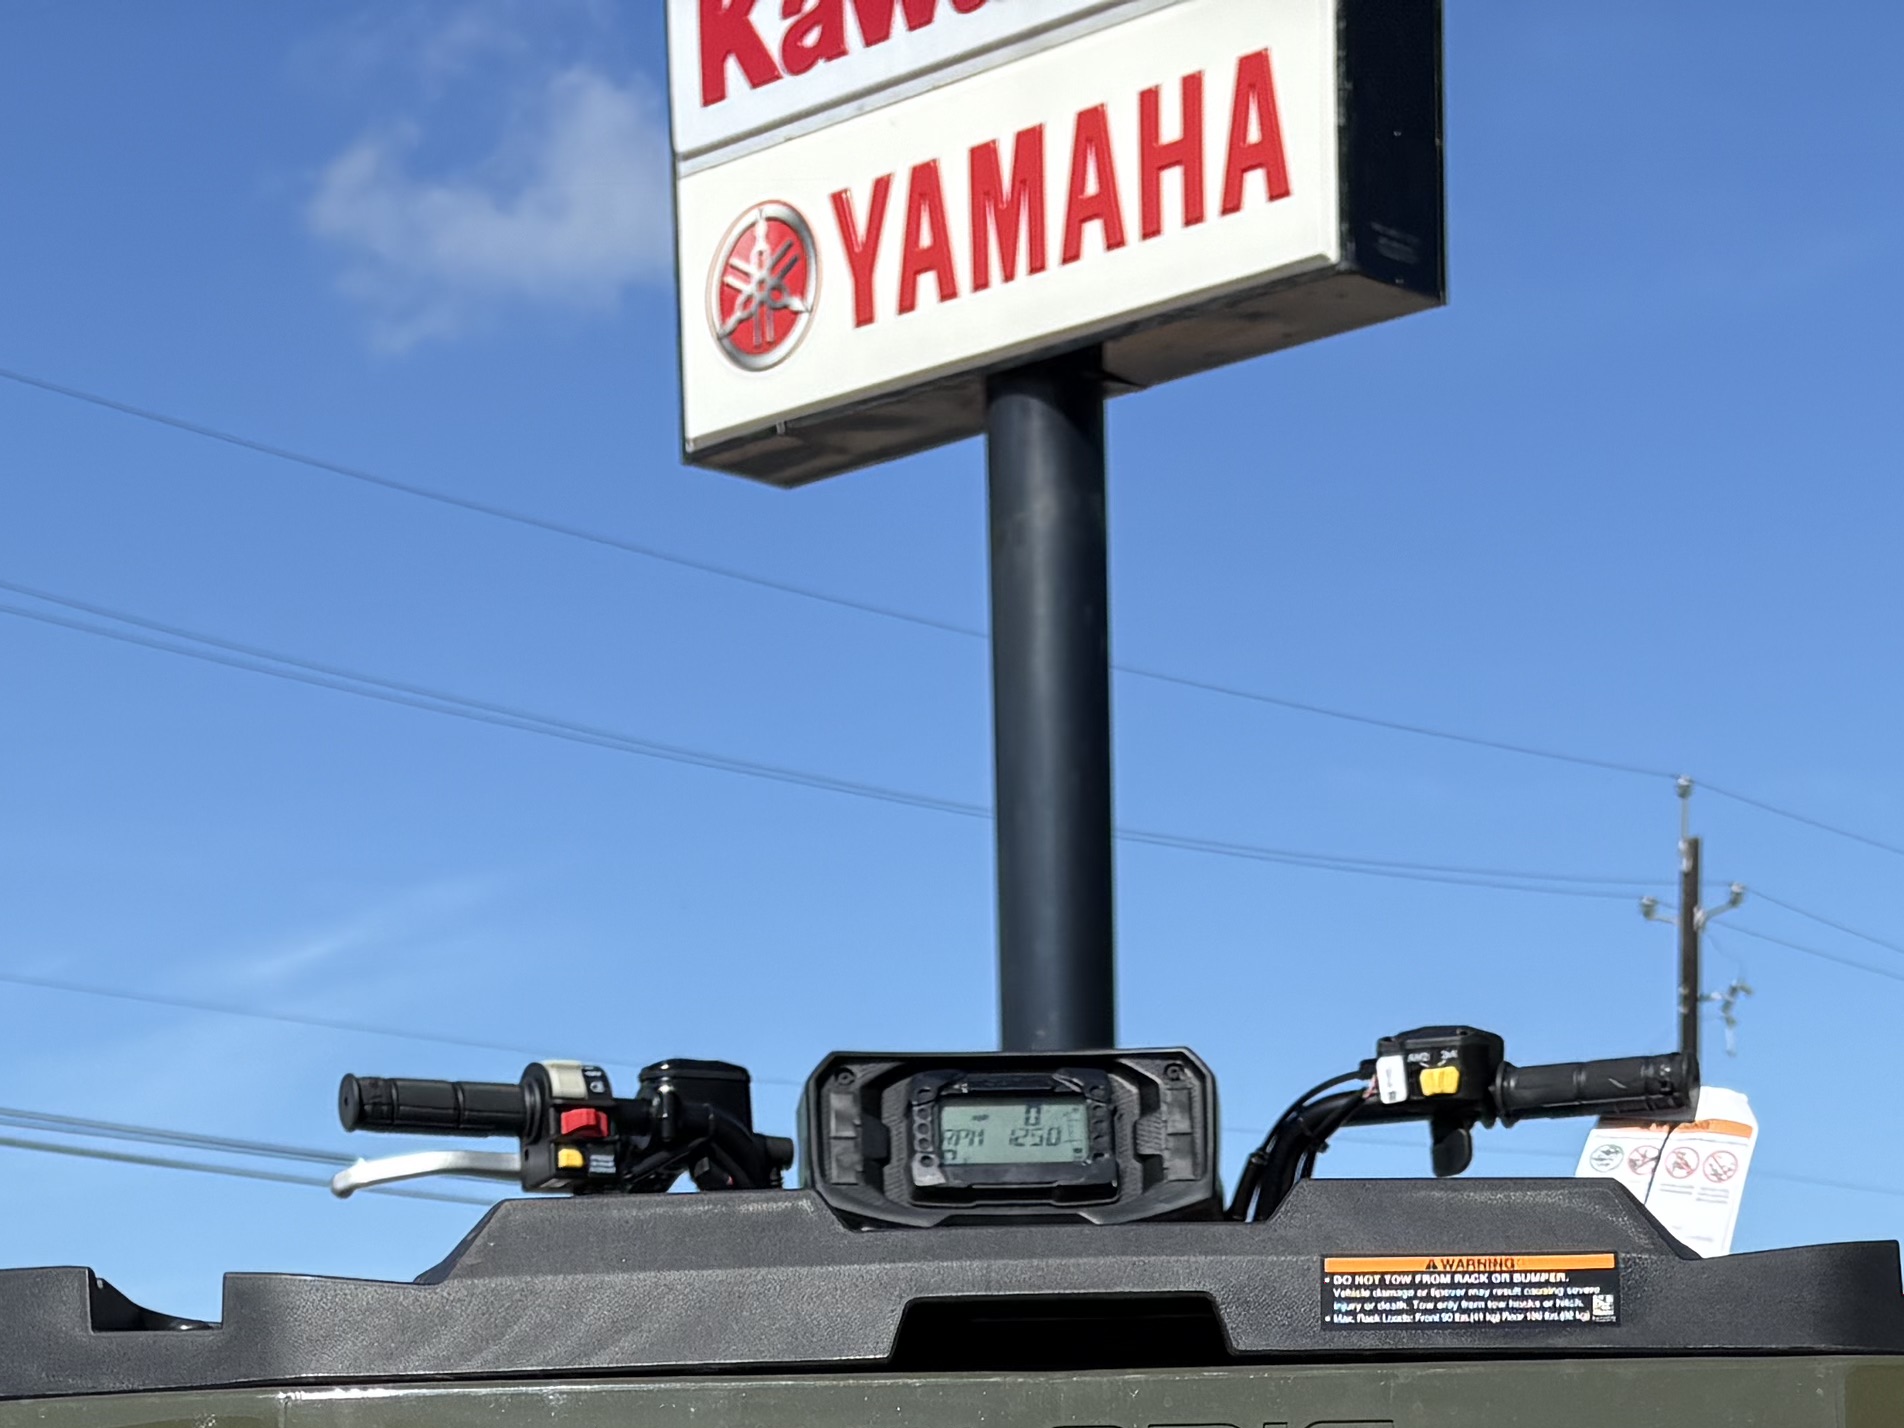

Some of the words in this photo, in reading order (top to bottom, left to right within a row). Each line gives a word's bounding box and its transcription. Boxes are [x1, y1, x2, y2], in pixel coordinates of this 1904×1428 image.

[829, 46, 1293, 330] YAMAHA
[1441, 1257, 1516, 1271] WARNING
[1333, 1274, 1352, 1285] DO
[1355, 1274, 1381, 1285] NOT
[1384, 1274, 1412, 1285] TOW
[1414, 1273, 1451, 1285] FROM
[1454, 1273, 1489, 1284] RACK
[1491, 1272, 1510, 1284] OR
